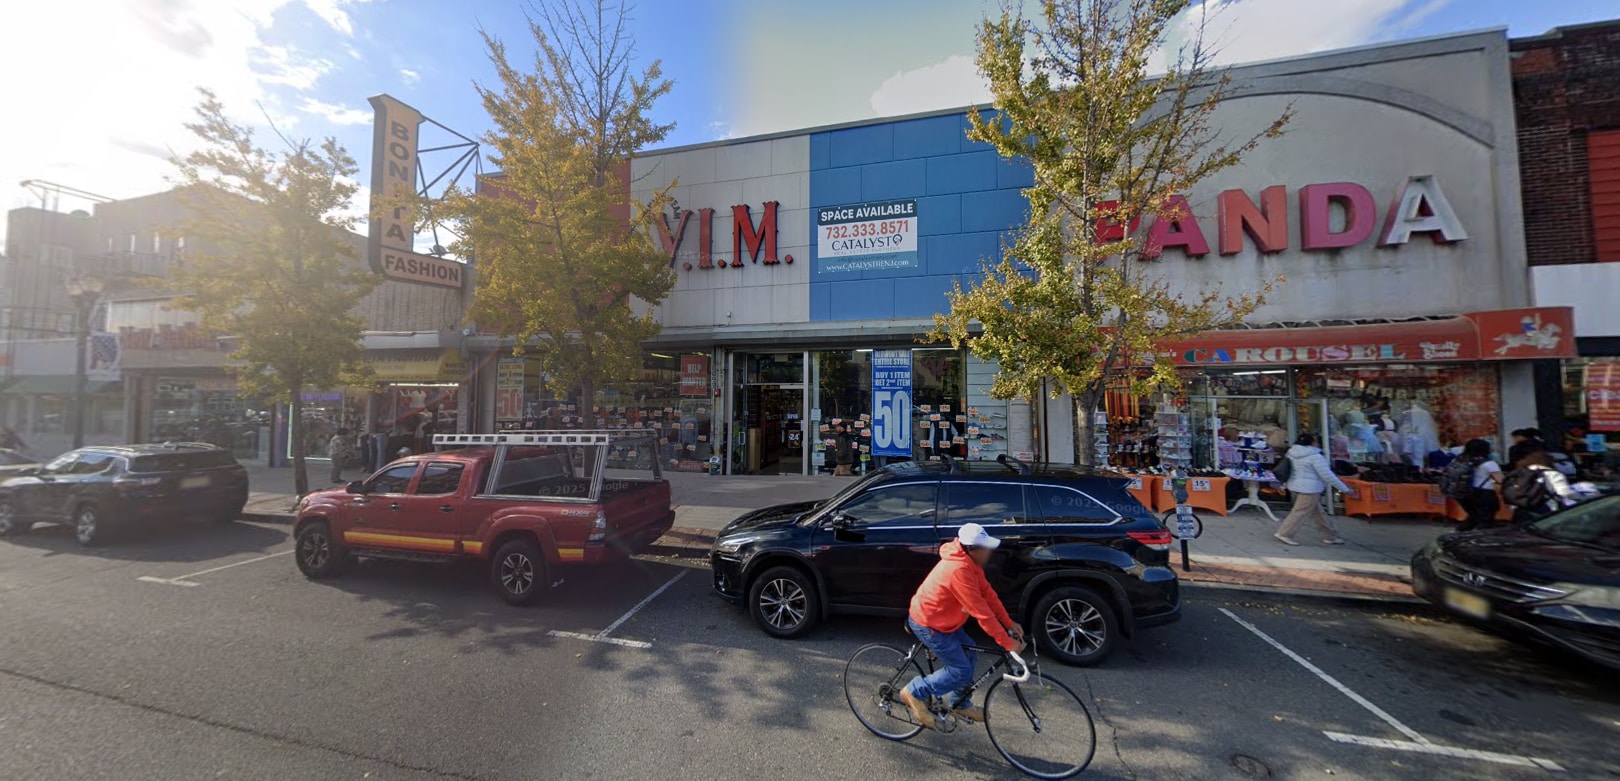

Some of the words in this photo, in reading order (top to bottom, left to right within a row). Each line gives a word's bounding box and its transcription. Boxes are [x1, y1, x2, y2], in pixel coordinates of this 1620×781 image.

[385, 120, 410, 242] BONTA
[821, 209, 854, 222] SPACE
[856, 203, 914, 218] AVAILABLE
[1092, 174, 1469, 261] PANDA
[826, 219, 909, 240] 732.333.8571
[831, 236, 893, 251] CATALYST
[384, 255, 459, 282] FASHION
[1183, 343, 1406, 364] CAROUSEL
[687, 364, 702, 373] HELP
[874, 390, 910, 449] 50
